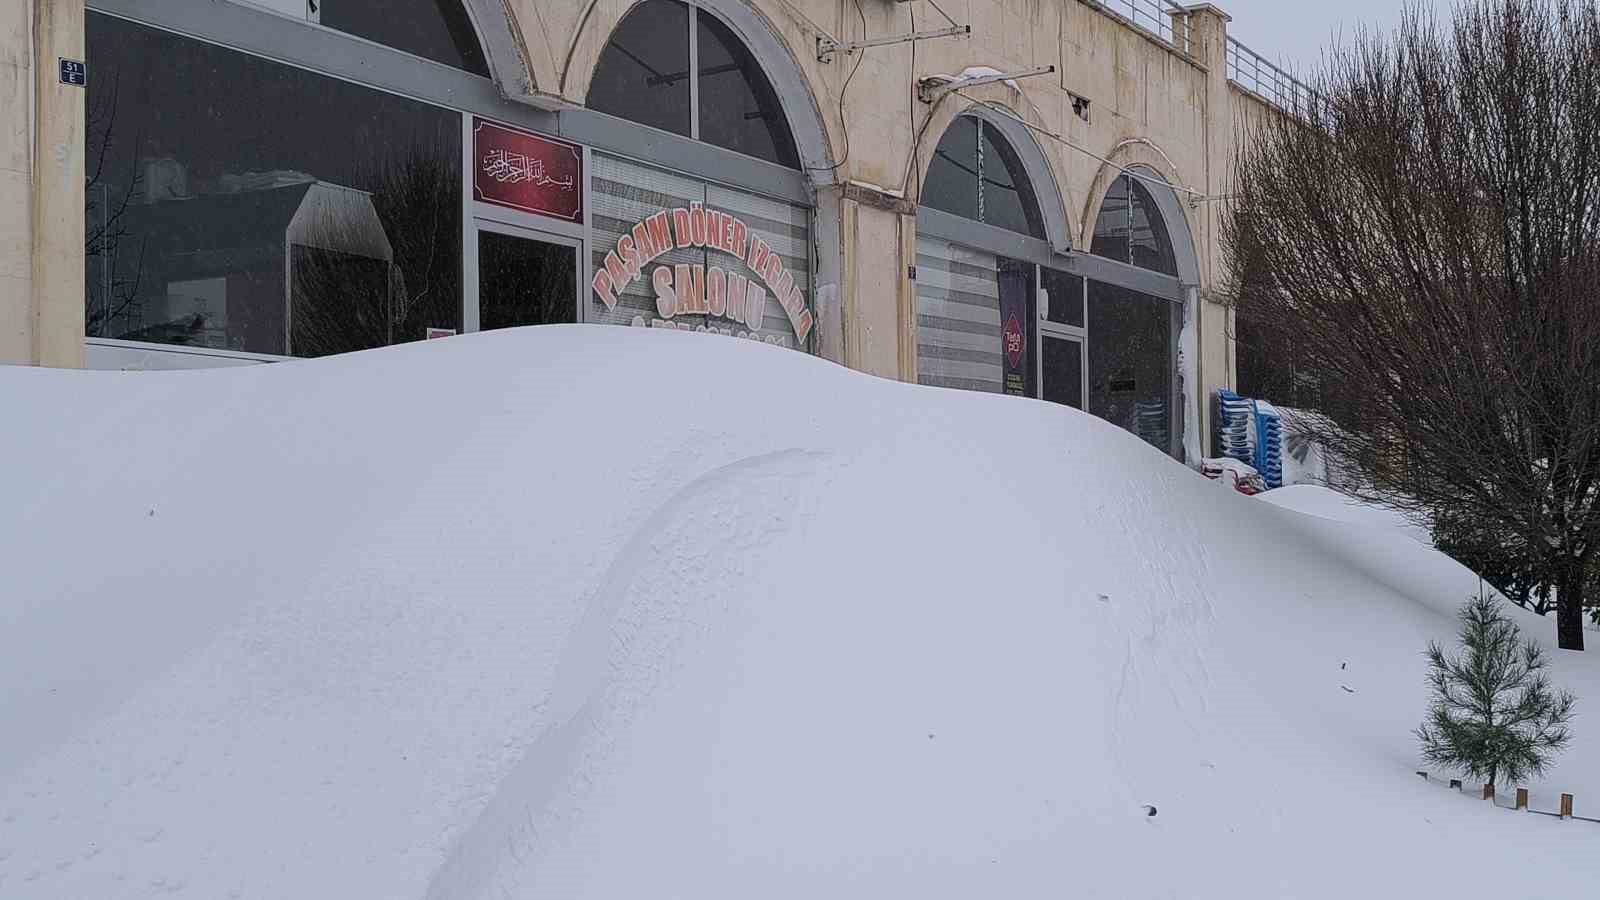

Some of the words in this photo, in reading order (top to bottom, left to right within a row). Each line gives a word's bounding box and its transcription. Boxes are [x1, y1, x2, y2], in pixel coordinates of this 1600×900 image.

[66, 62, 77, 71] 51
[69, 72, 75, 82] E
[592, 210, 673, 312] PAŞAM
[672, 200, 748, 260] DÖNER
[652, 263, 766, 331] SALONU
